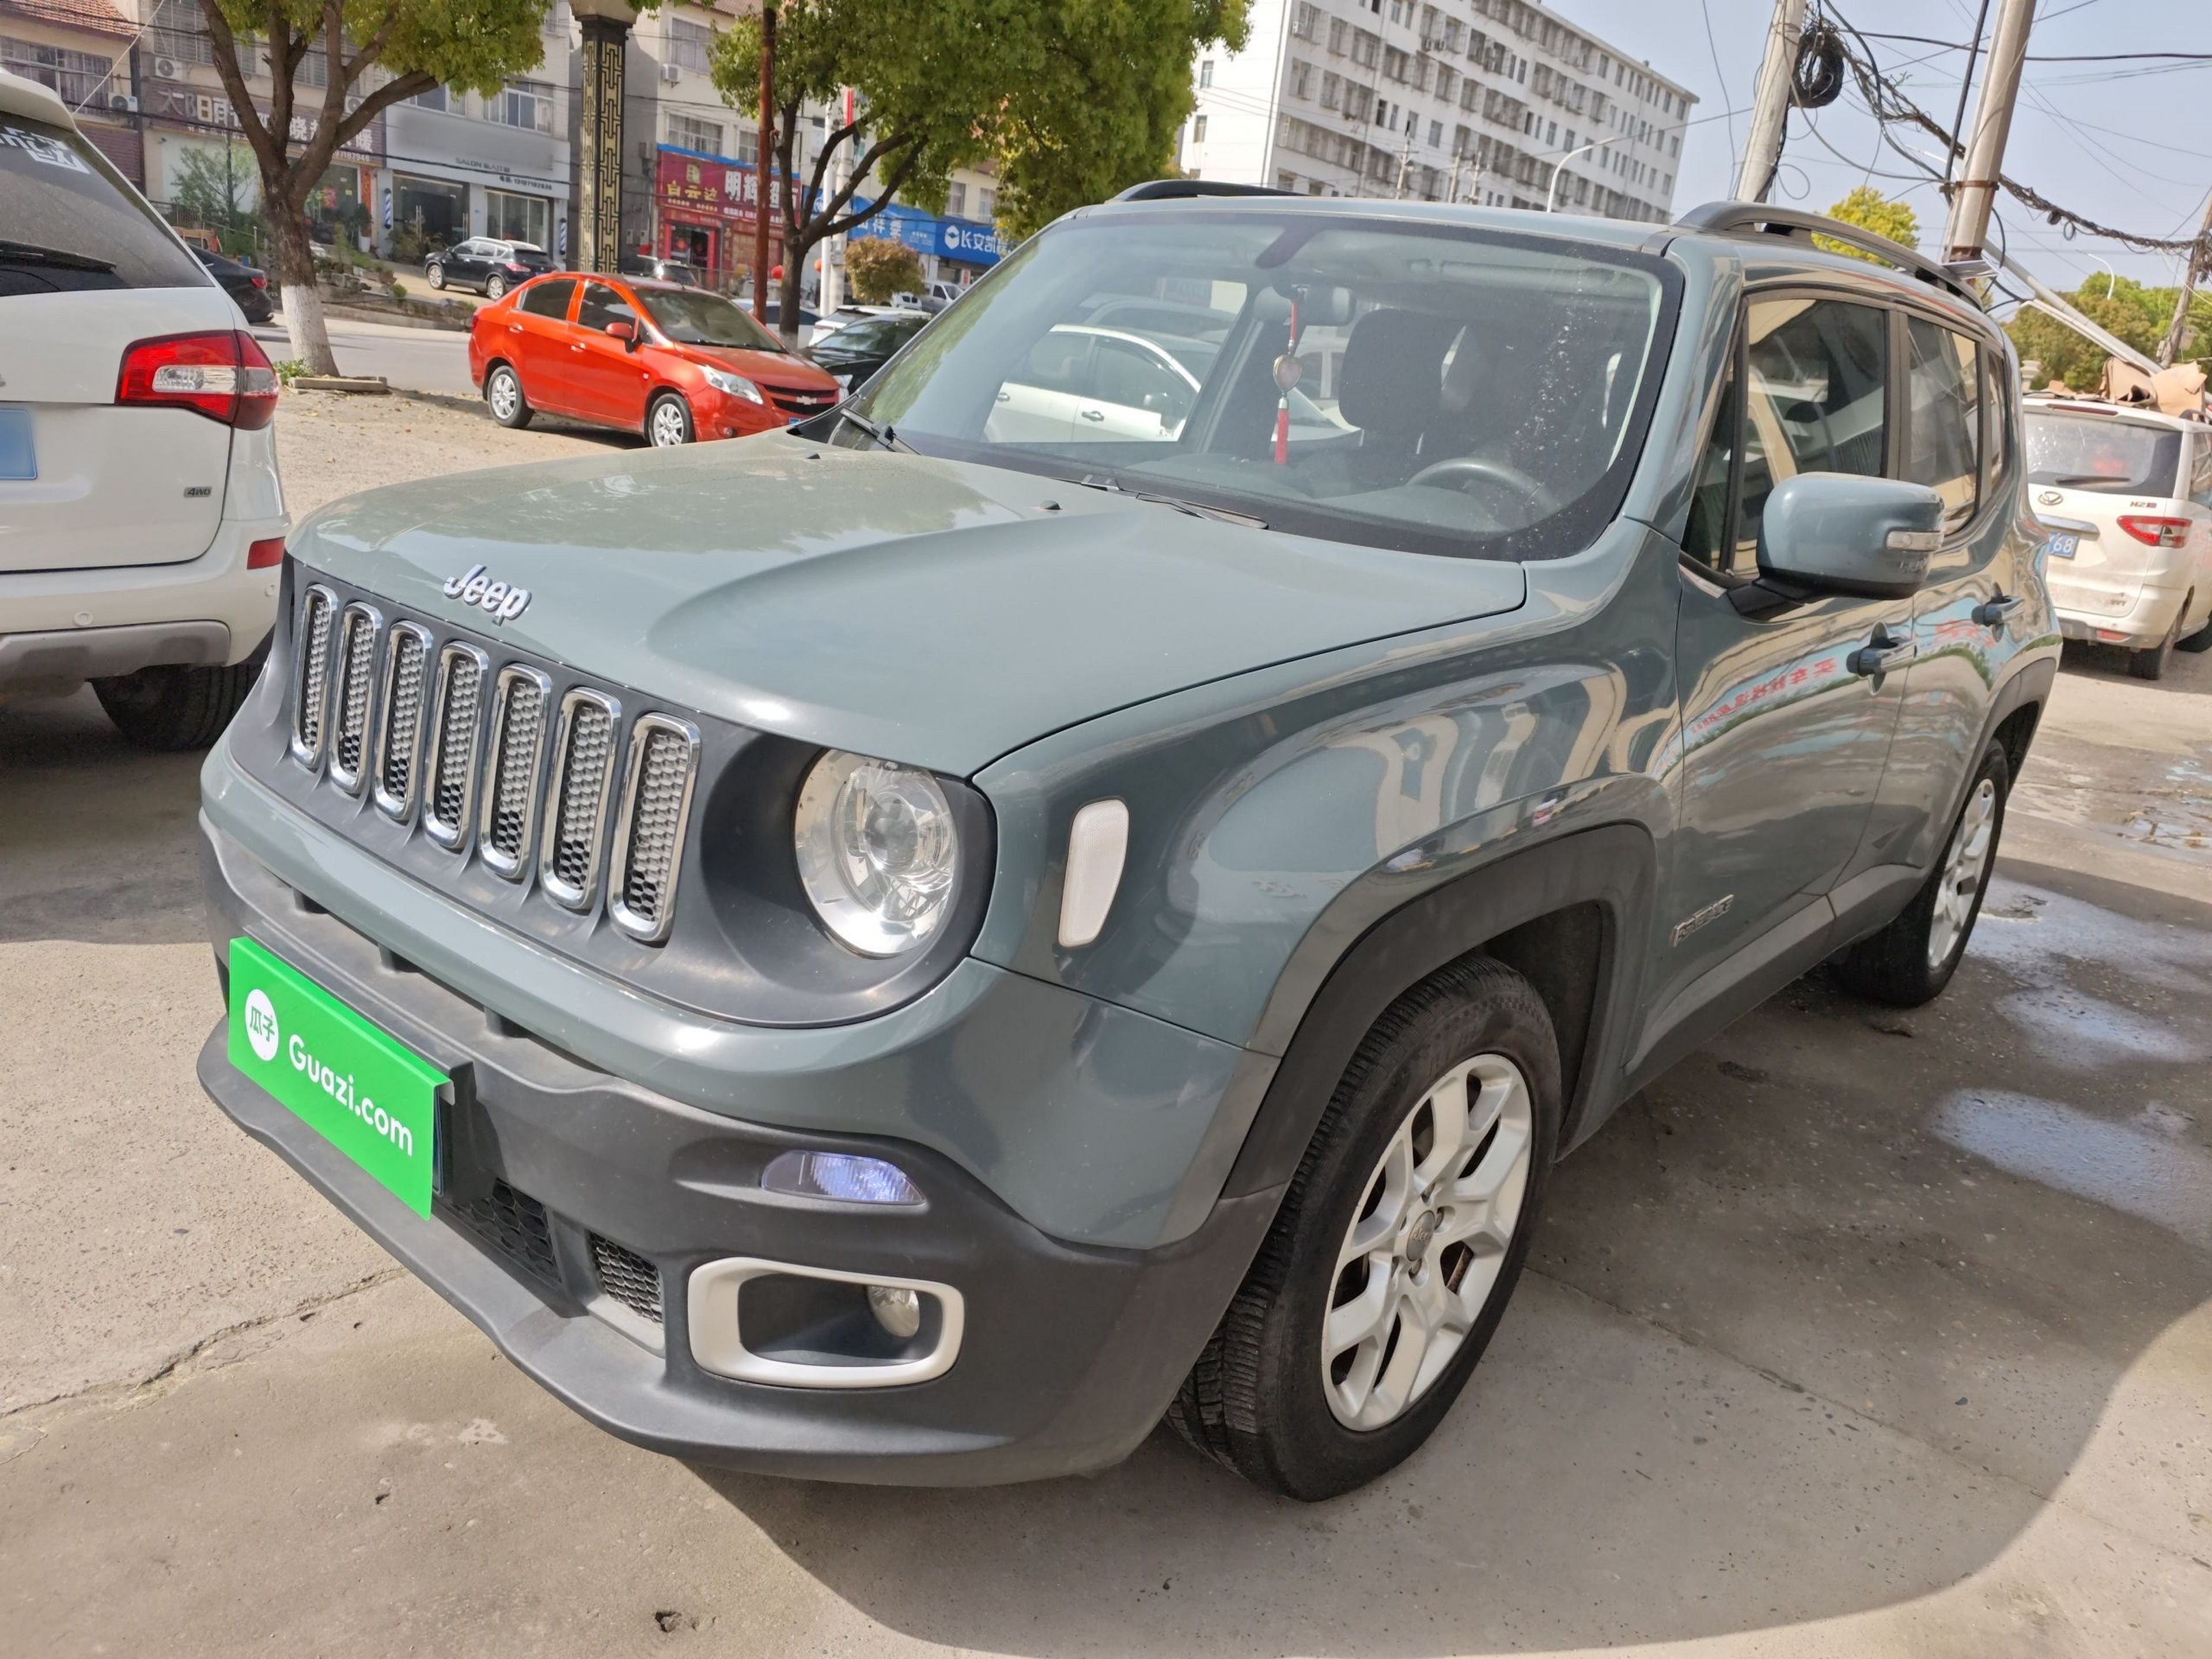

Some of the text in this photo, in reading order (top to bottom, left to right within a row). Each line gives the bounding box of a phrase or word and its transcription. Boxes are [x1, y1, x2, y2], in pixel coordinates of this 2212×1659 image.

[456, 157, 482, 168] SALON
[443, 563, 532, 627] Jeep
[249, 1005, 275, 1043] 瓜子
[289, 1033, 413, 1157] Guazi.com
